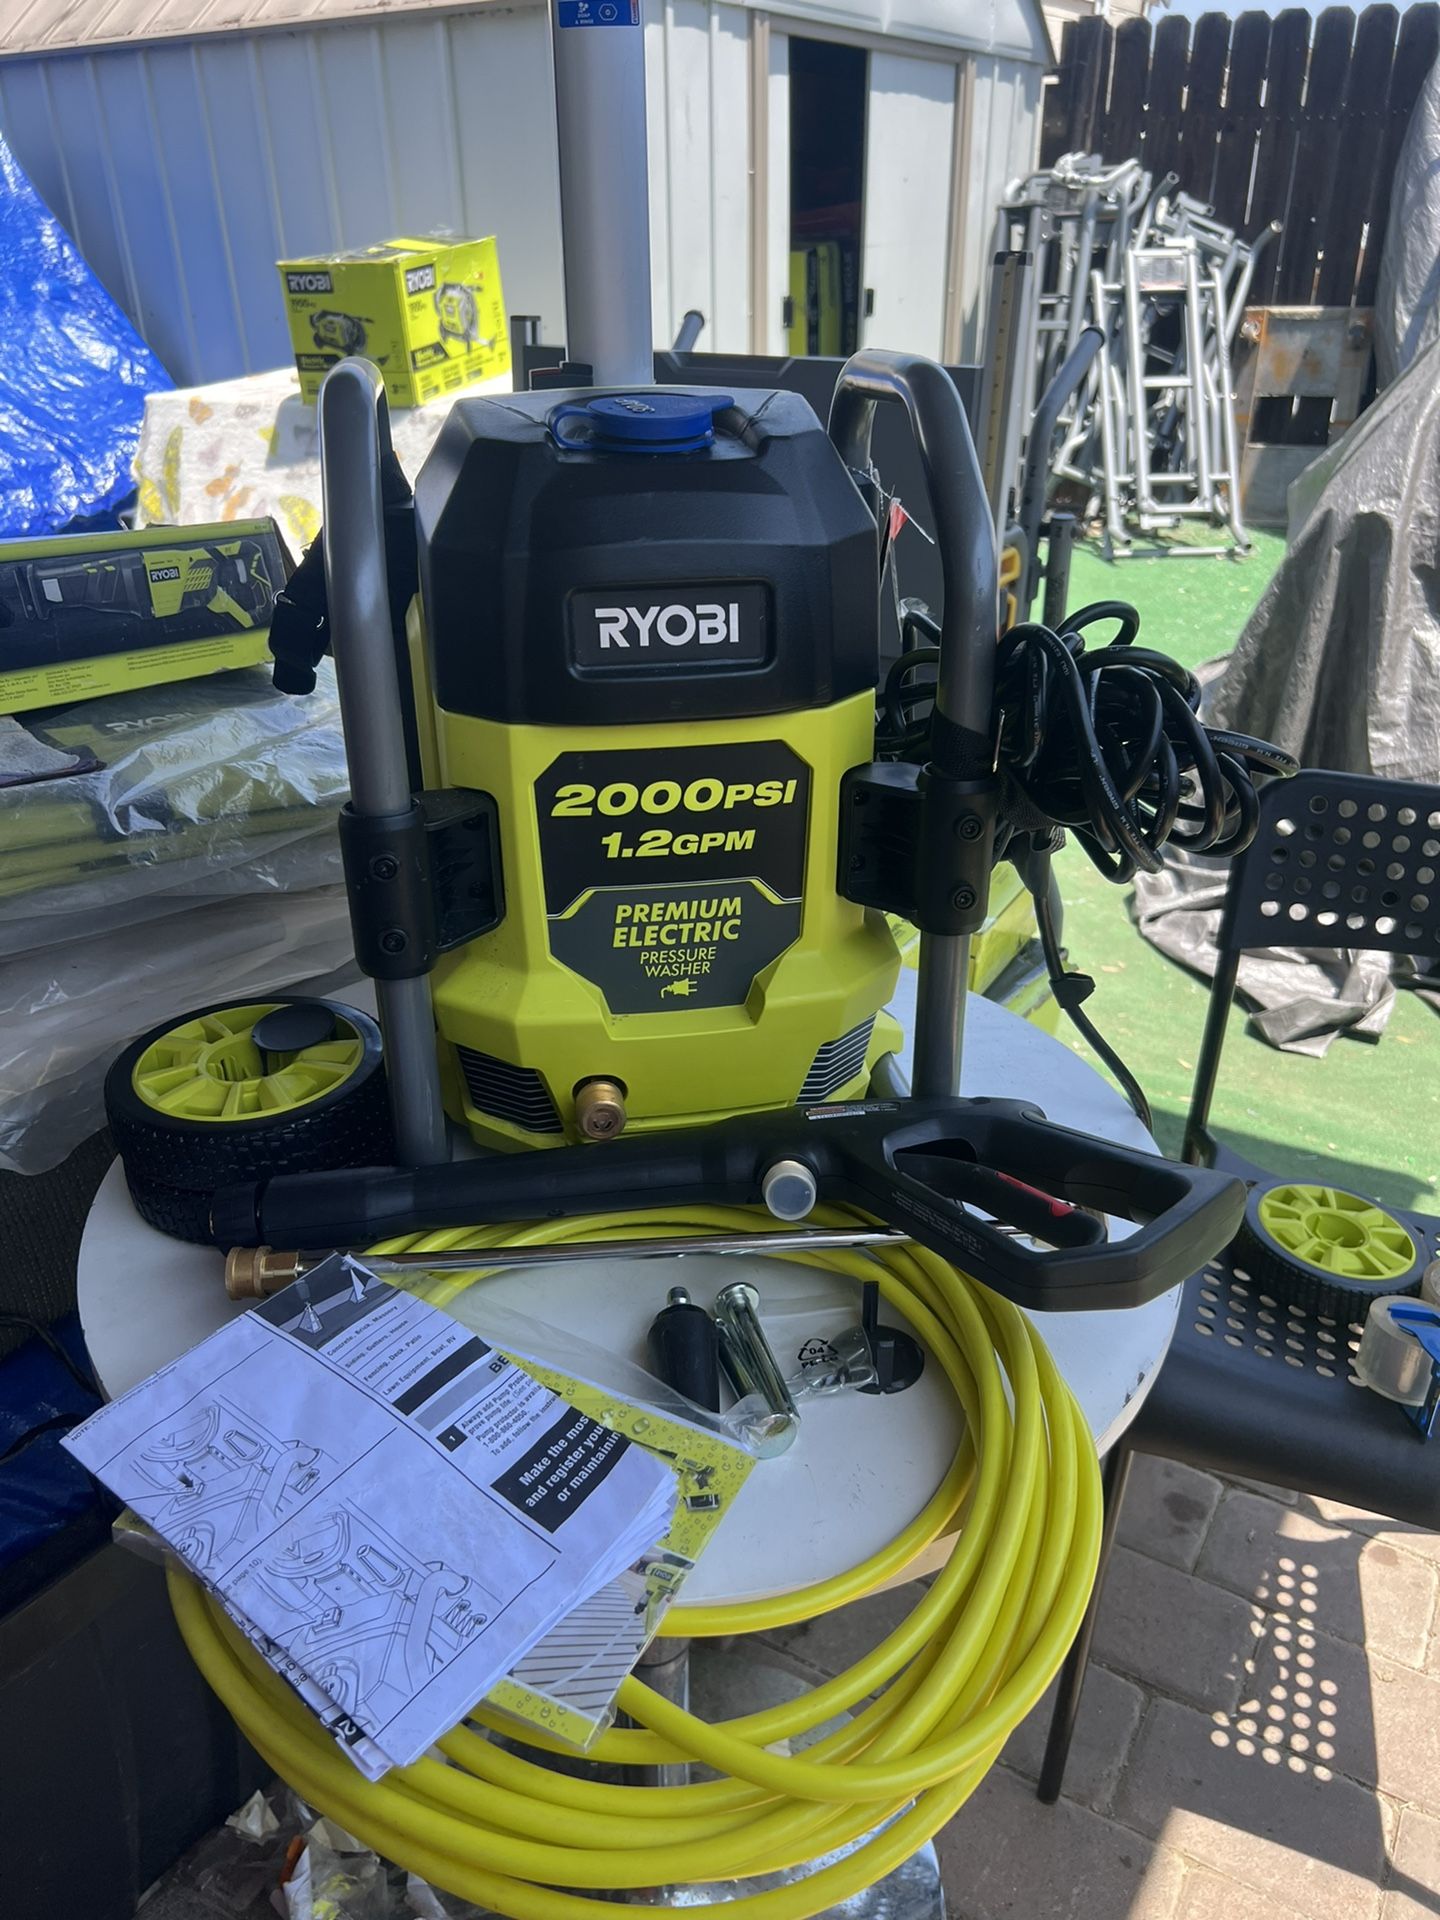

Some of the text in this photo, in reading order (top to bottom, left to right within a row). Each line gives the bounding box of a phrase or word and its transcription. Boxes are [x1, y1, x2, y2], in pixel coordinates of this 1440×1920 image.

[288, 274, 331, 291] RYOBI
[405, 266, 435, 292] RYOBI
[151, 569, 180, 582] RYOBI
[595, 603, 740, 649] RYOBI
[551, 778, 798, 817] 2000PSI
[600, 829, 756, 858] 1.2GPM
[615, 896, 742, 924] PREMIUM
[613, 919, 741, 948] ELECTRIC
[640, 947, 717, 965] PRESSURE
[645, 961, 711, 978] WASHER
[327, 1334, 357, 1357] Concrete,
[354, 1322, 371, 1335] Brick,
[372, 1305, 399, 1323] Masonry
[344, 1319, 409, 1369] Siding, Gutters, House
[363, 1334, 422, 1382] Fencing, Deck, Patio
[382, 1335, 457, 1396] Lawn Equipment, Boat, RV
[461, 1411, 483, 1429] Always
[482, 1401, 494, 1413] add
[491, 1387, 511, 1408] Pump
[468, 1419, 486, 1435] prove
[484, 1406, 502, 1422] pump
[500, 1399, 512, 1410] life.
[475, 1426, 495, 1442] Pump
[493, 1406, 519, 1429] protector
[518, 1400, 526, 1409] is
[70, 1424, 91, 1442] NOTE:
[490, 1447, 500, 1457] To
[500, 1436, 515, 1449] add,
[511, 1422, 531, 1439] follow
[530, 1413, 541, 1424] the
[518, 1415, 590, 1487] Make the mos
[525, 1485, 548, 1507] and
[545, 1445, 586, 1488] register
[556, 1431, 621, 1502] or maintainin
[232, 1570, 250, 1587] page
